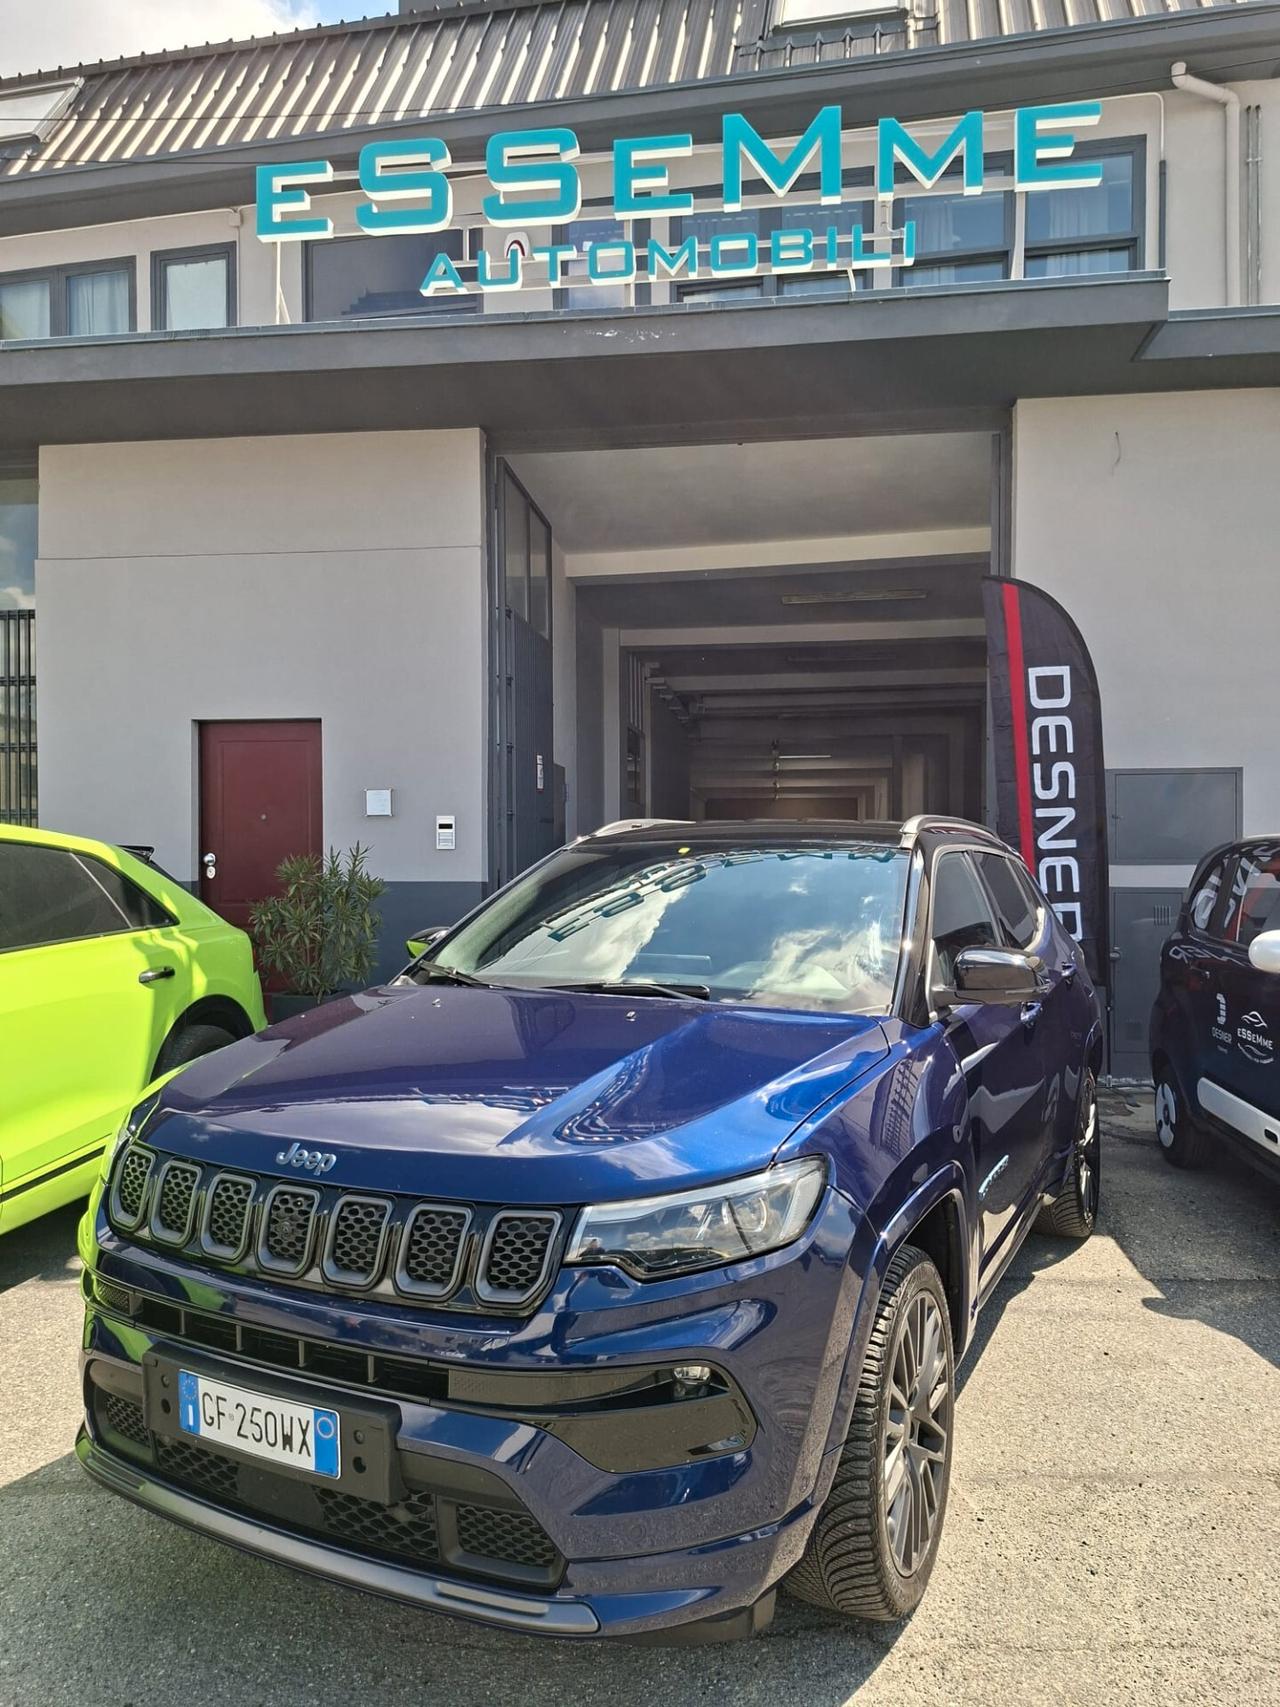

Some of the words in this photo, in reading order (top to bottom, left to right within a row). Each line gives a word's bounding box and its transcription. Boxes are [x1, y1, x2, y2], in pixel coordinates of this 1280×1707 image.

[256, 101, 1103, 244] ESSEMME
[419, 220, 916, 297] AUTOMOBILI
[276, 1142, 337, 1176] Jeep
[202, 1391, 228, 1431] GF
[235, 1402, 312, 1458] 250WX
